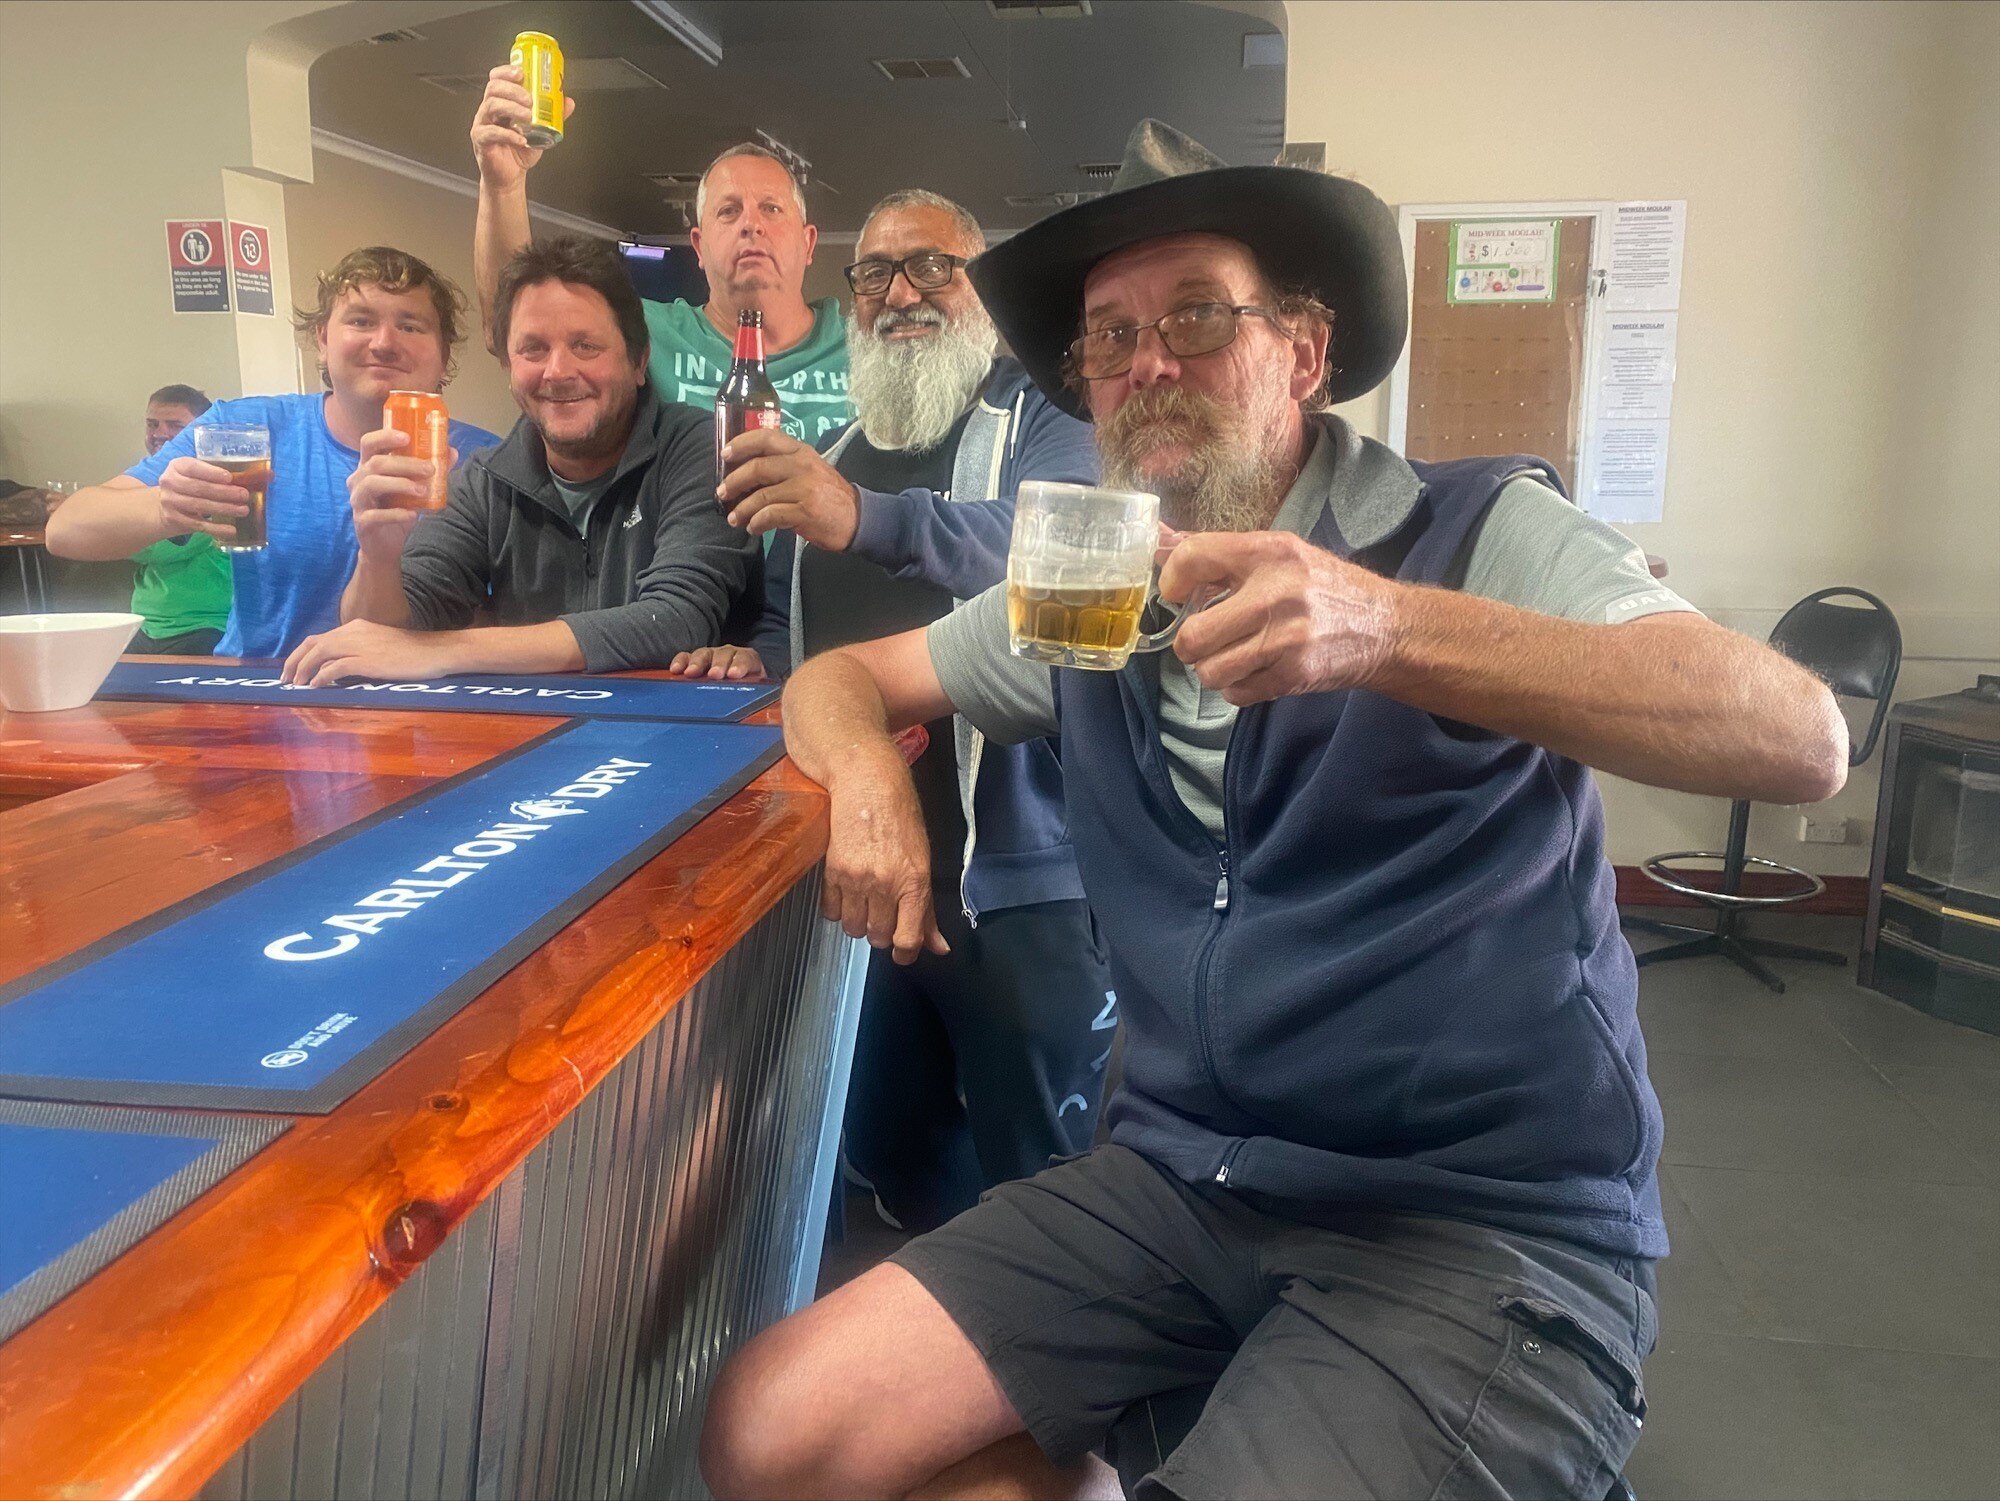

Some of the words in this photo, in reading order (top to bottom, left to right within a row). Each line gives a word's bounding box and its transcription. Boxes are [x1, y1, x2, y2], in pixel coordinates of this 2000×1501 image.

[244, 243, 257, 259] 18
[674, 353, 706, 380] IN
[156, 676, 282, 687] DRY
[347, 682, 613, 699] CARLTON
[264, 822, 552, 961] CARLTON
[550, 757, 652, 798] DRY
